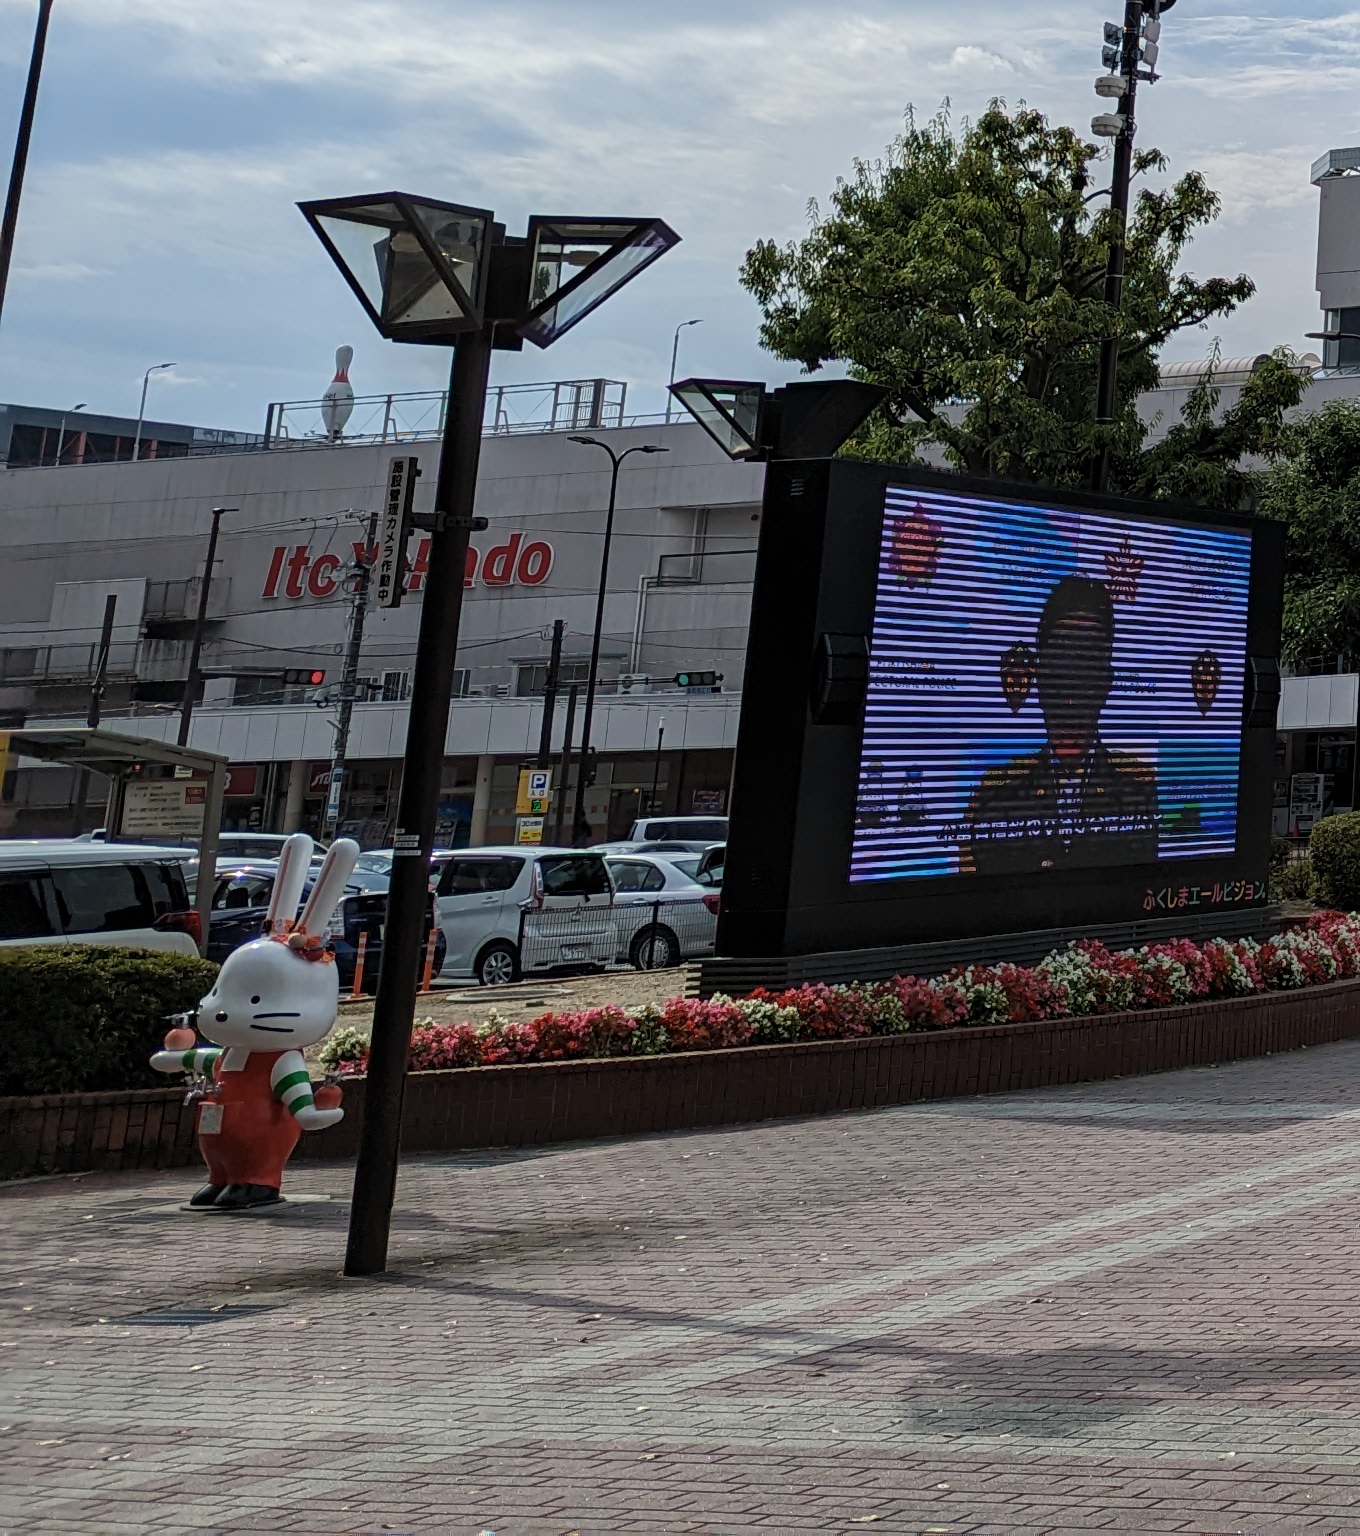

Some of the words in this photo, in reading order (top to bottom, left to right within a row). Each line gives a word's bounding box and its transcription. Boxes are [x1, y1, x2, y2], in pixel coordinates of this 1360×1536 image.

[377, 460, 404, 602] 施設管理カメラ作動中
